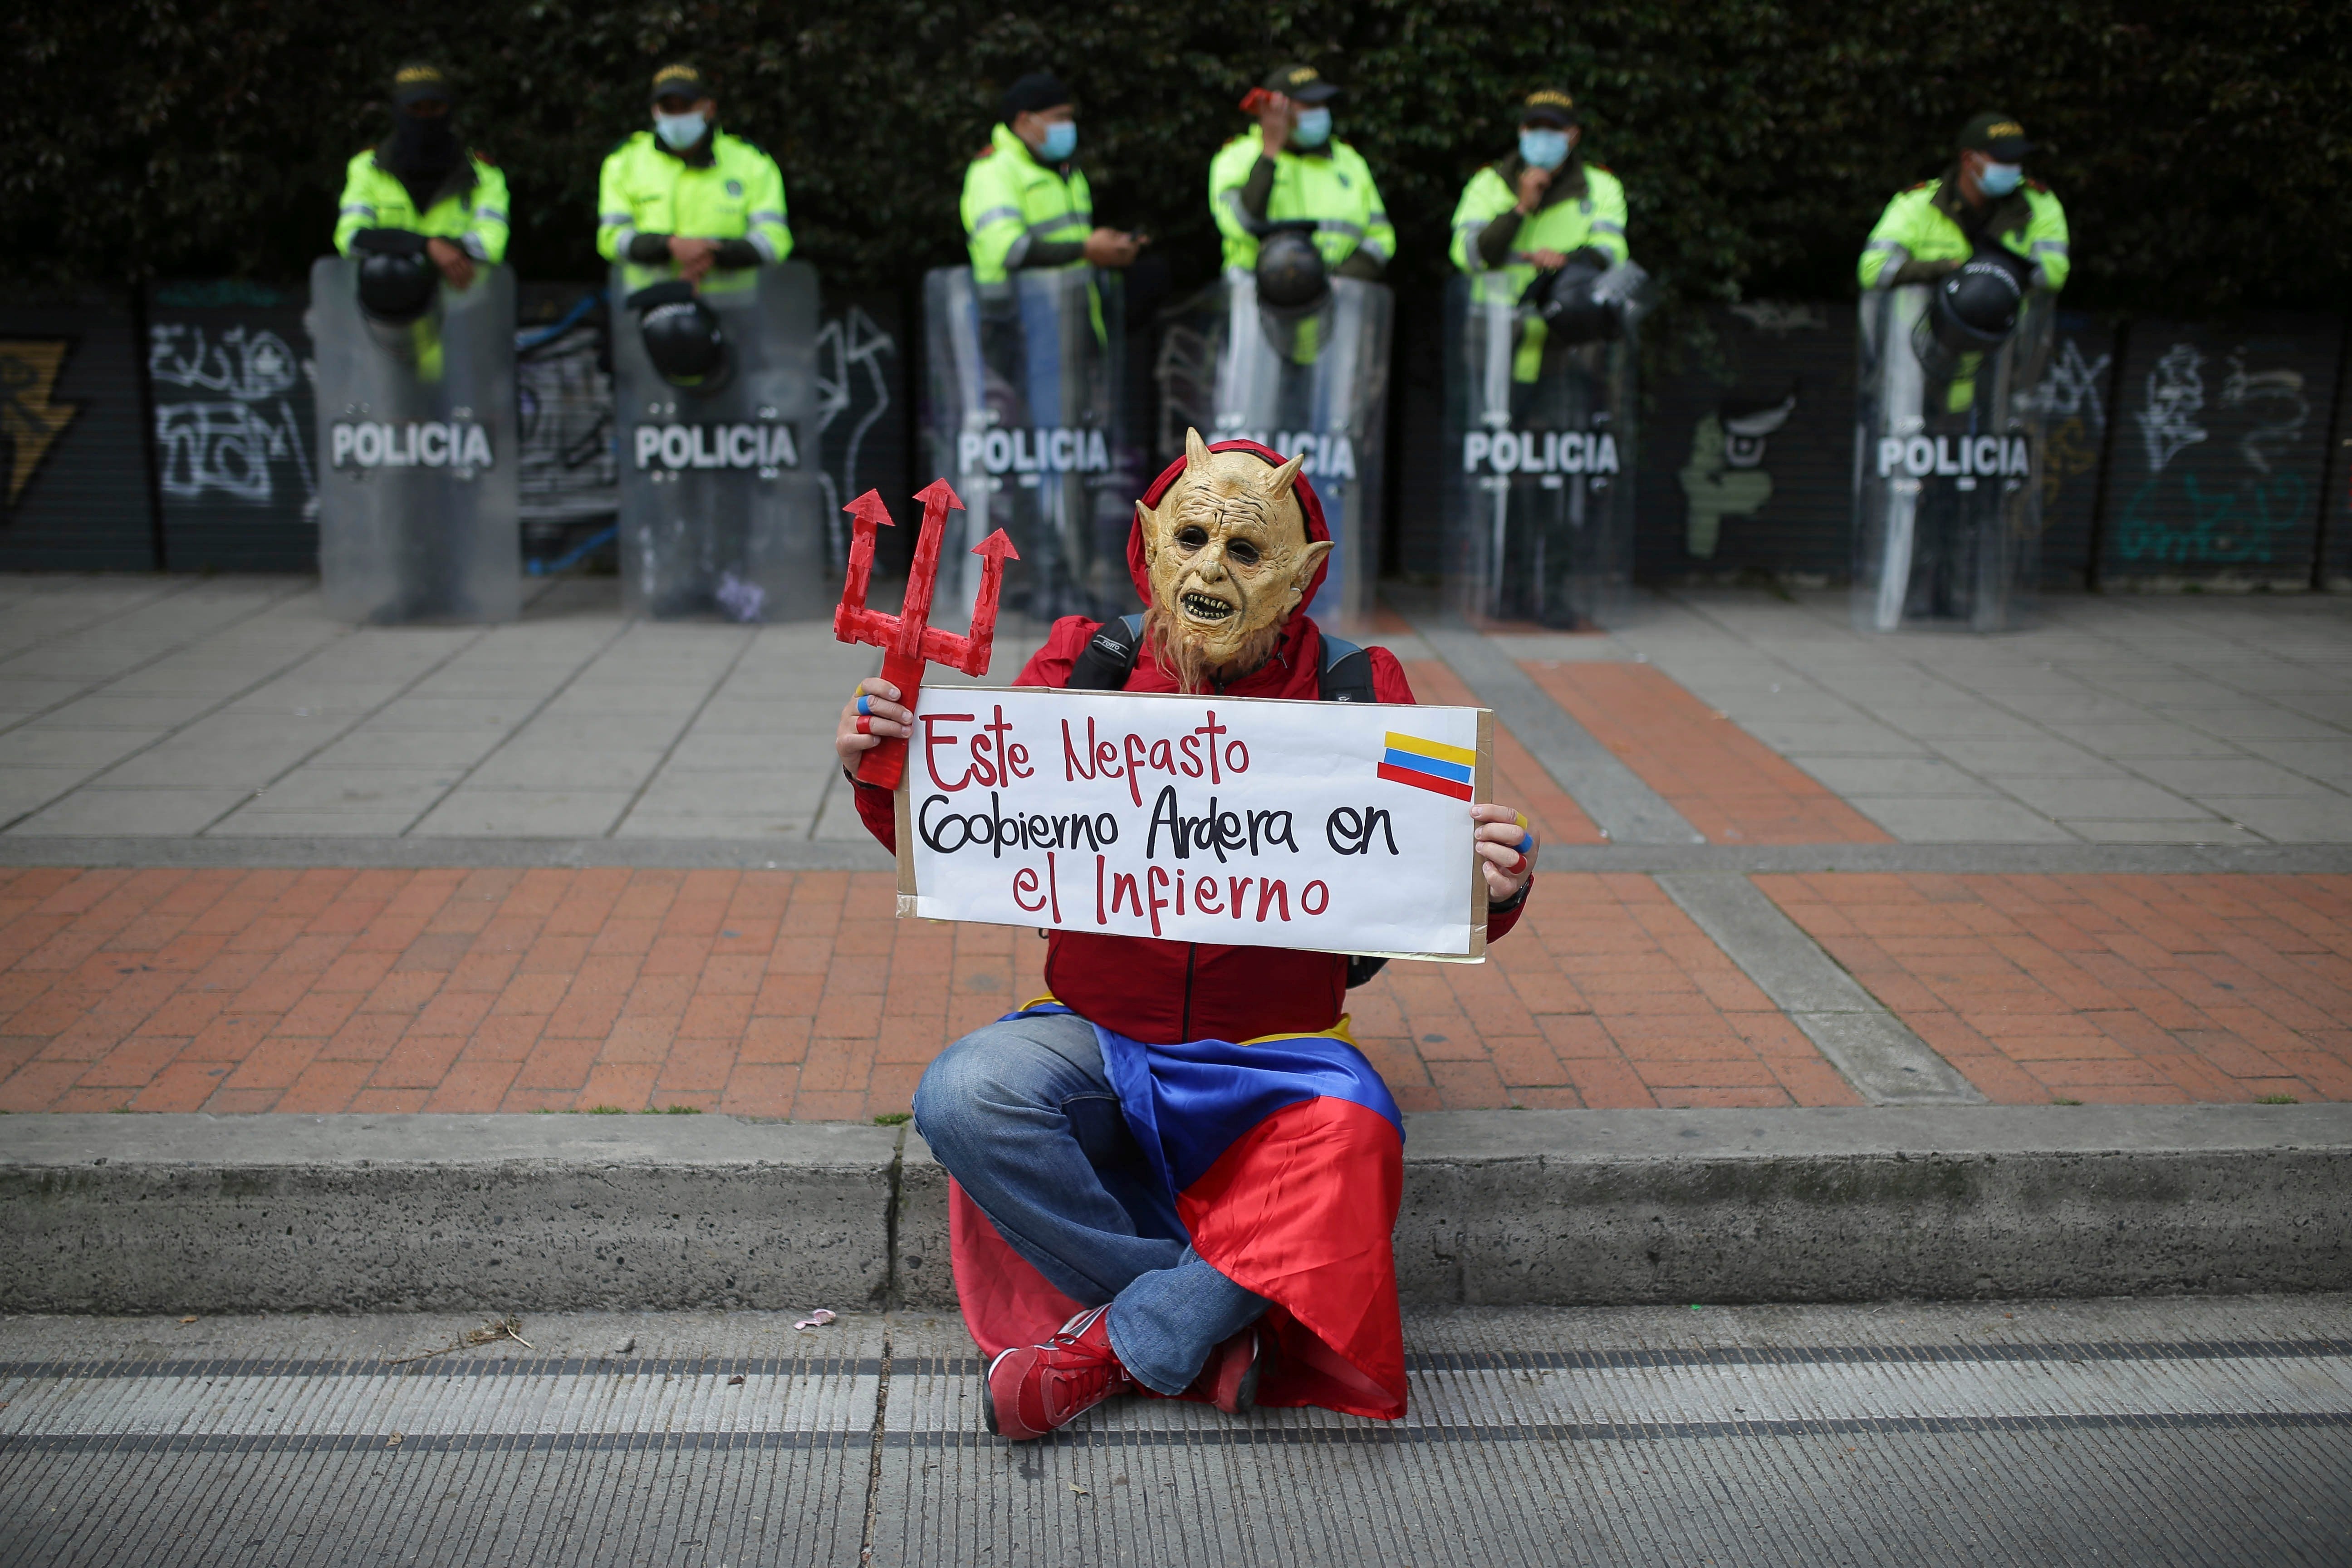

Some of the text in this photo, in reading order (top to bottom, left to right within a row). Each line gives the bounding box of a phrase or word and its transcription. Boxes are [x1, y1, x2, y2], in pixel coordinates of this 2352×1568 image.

[332, 421, 493, 468] POLICIA
[635, 422, 799, 469] POLICIA
[958, 428, 1109, 475] POLICIA
[1464, 430, 1620, 474] POLICIA
[1878, 435, 2030, 478] POLICIA
[1102, 639, 1120, 650] TOTTO
[919, 704, 1249, 808] Este Nefasto
[918, 784, 1400, 863] Gobierno Ardera en
[1013, 851, 1330, 937] el Infierno
